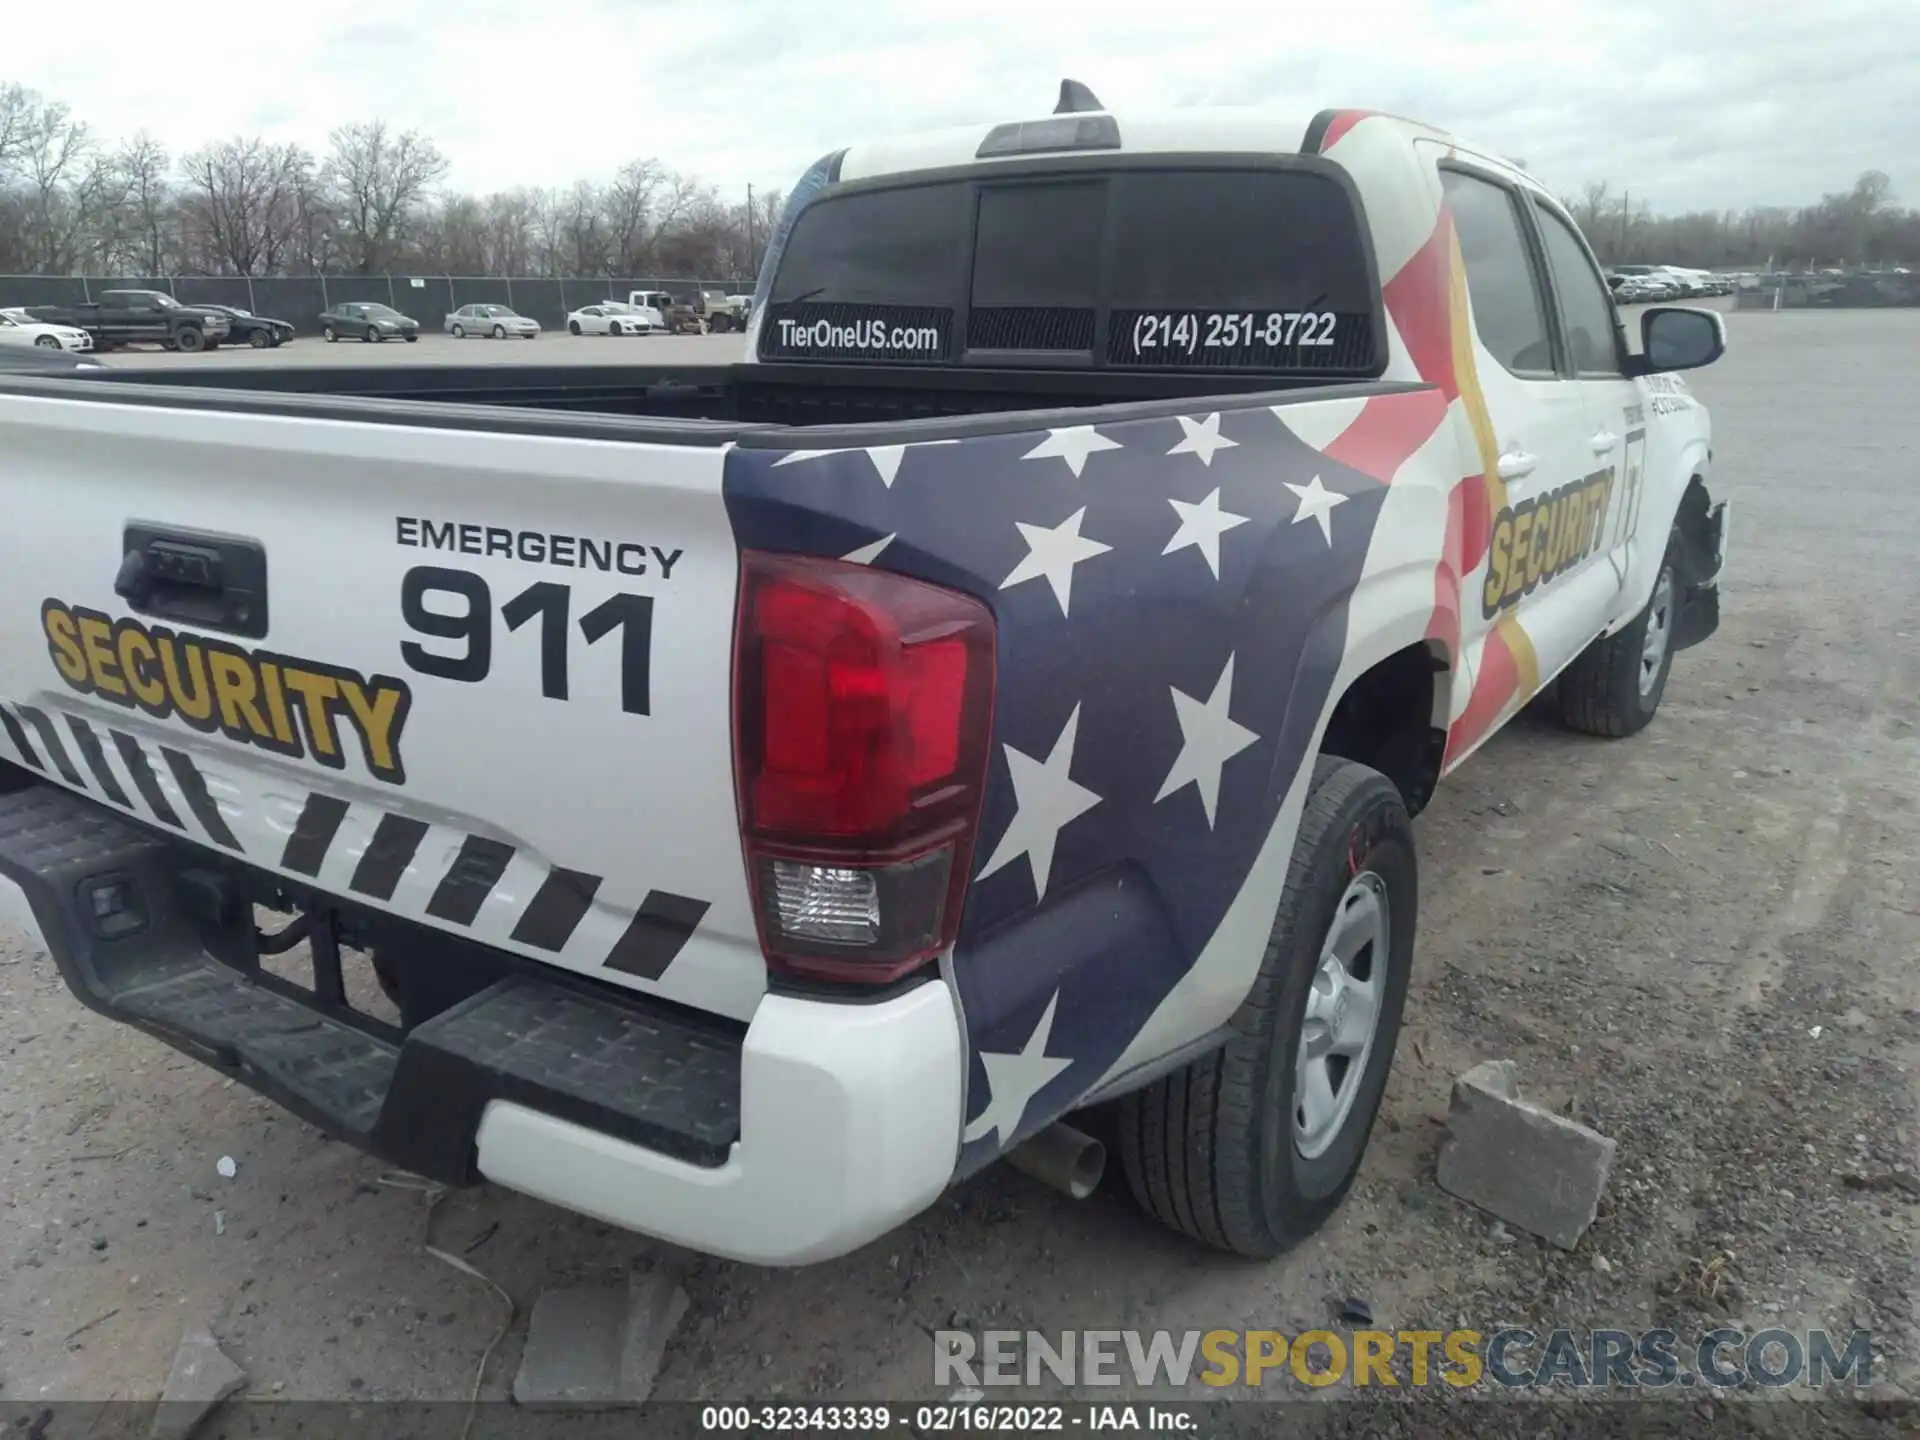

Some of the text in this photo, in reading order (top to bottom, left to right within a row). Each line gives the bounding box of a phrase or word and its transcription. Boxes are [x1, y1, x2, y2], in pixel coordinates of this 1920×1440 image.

[778, 319, 938, 350] TierOneUS.com
[1133, 311, 1337, 356] (214) 251-8722
[395, 516, 684, 580] EMERGENCY
[1482, 466, 1615, 618] SECURITY
[43, 600, 410, 781] SECURITY
[399, 565, 654, 716] 911
